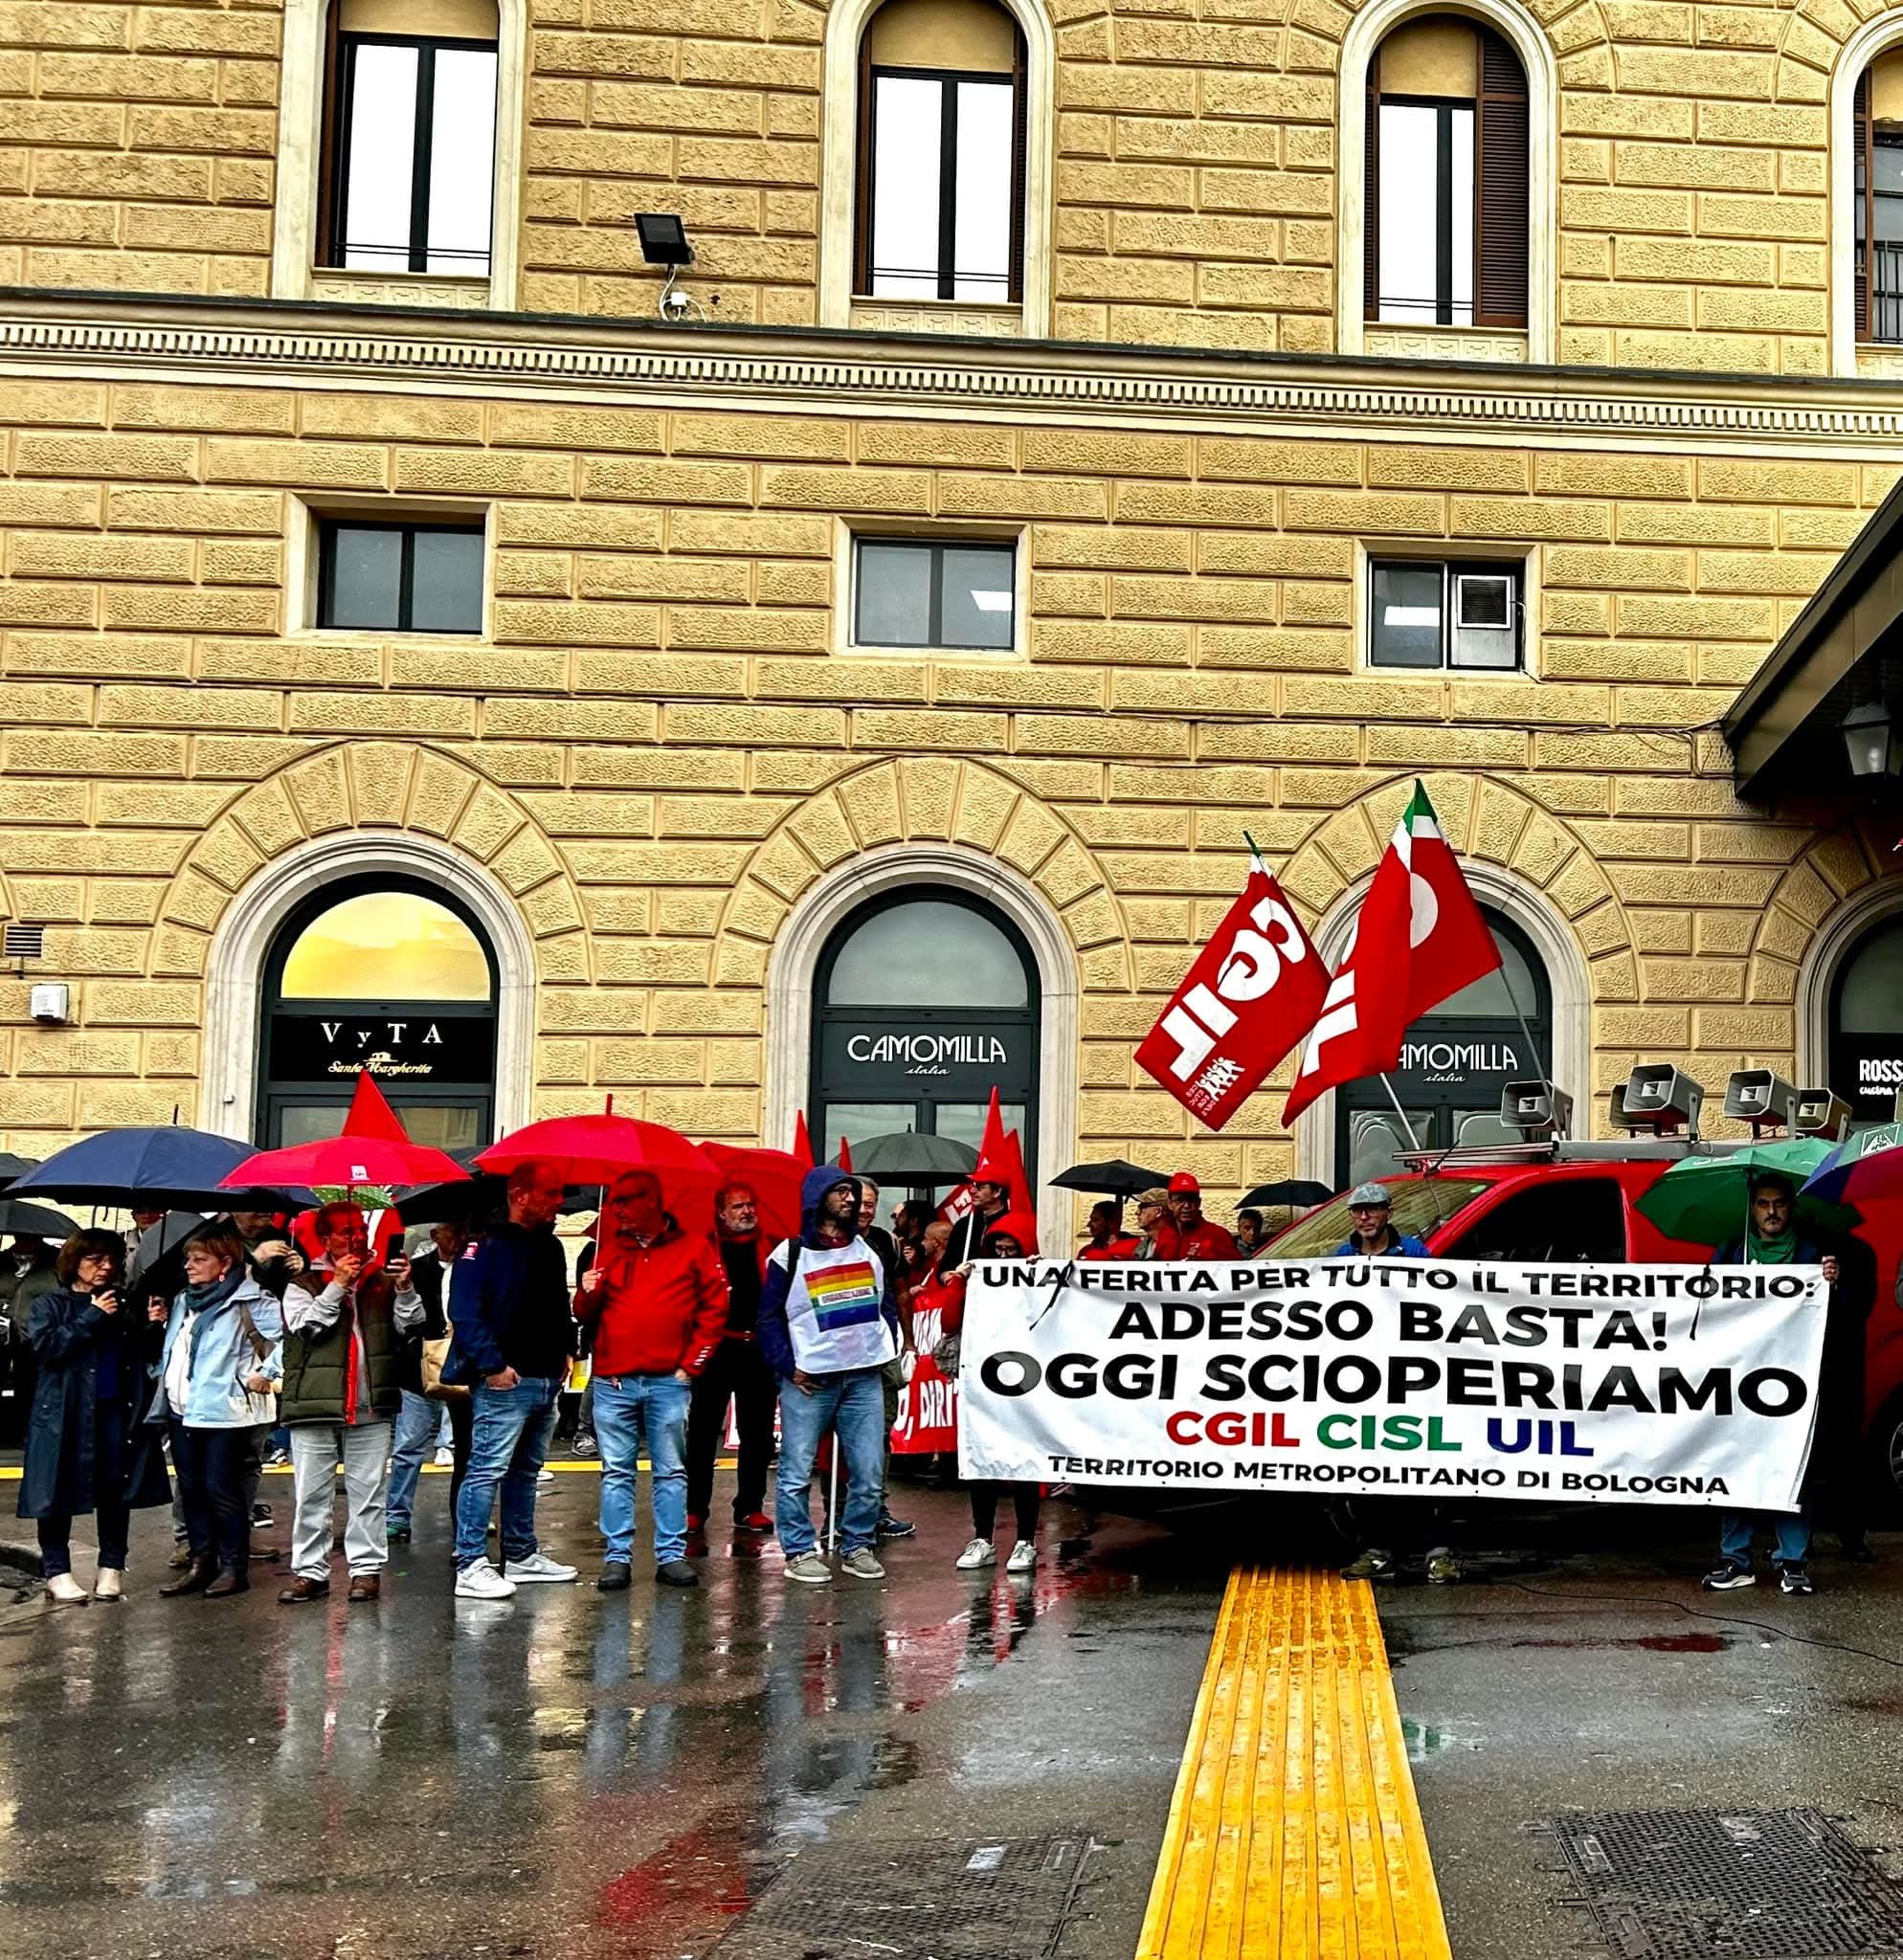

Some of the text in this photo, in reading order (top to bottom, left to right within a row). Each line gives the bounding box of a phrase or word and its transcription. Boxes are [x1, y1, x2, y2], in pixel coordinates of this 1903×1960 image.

[847, 1035, 1007, 1063] CAMOMILLA
[1399, 1043, 1518, 1070] AMOMILLA
[327, 1060, 433, 1077] Santa Margherita
[904, 1064, 951, 1075] italia
[1422, 1072, 1466, 1082] italia
[1859, 1086, 1894, 1095] cucina
[982, 1265, 1815, 1300] UNA FERITA PER TUTTO IL TERRITORIO:
[1108, 1301, 1667, 1351] ADESSO BASTA!
[981, 1350, 1808, 1417] OGGI SCIOPERIAMO
[1167, 1412, 1595, 1457] CGIL CISL UIL
[1048, 1456, 1730, 1496] TERRITORIO METROPOLITANO DI BOLOGNA
